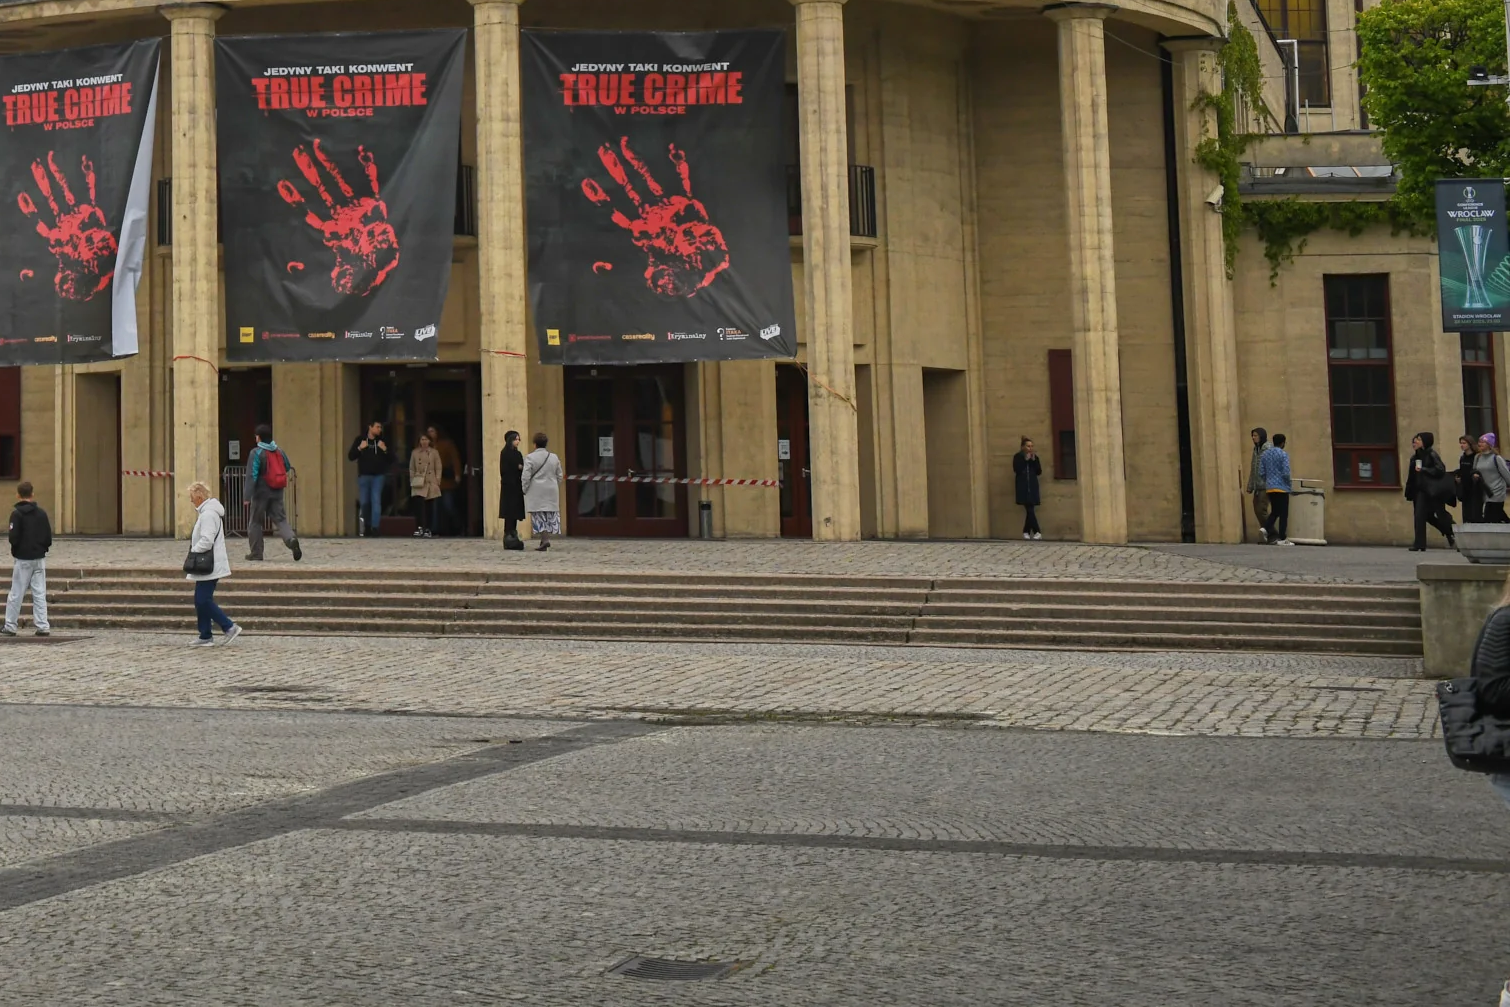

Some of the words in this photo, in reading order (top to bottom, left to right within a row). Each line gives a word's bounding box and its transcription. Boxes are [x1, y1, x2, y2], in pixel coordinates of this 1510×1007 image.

[263, 67, 313, 76] JEDYNY
[316, 65, 345, 74] TAKI
[348, 63, 414, 74] KONWENT
[571, 63, 625, 72] JEDYNY
[628, 63, 658, 72] TAKI
[662, 62, 730, 73] KONWENT
[11, 82, 49, 94] JEDYNY
[51, 80, 73, 89] TAKI
[76, 73, 123, 87] KONWENT
[559, 73, 636, 106] TRUE
[643, 72, 743, 106] CRIME
[251, 76, 326, 110] TRUE
[333, 73, 427, 108] CRIME
[2, 91, 59, 126] TRUE
[64, 82, 132, 121] CRIME
[614, 106, 627, 115] W
[631, 105, 686, 115] POLSCE
[306, 109, 319, 118] W
[322, 108, 374, 117] POLSCE
[43, 123, 53, 131] W
[56, 119, 95, 130] POLSCE
